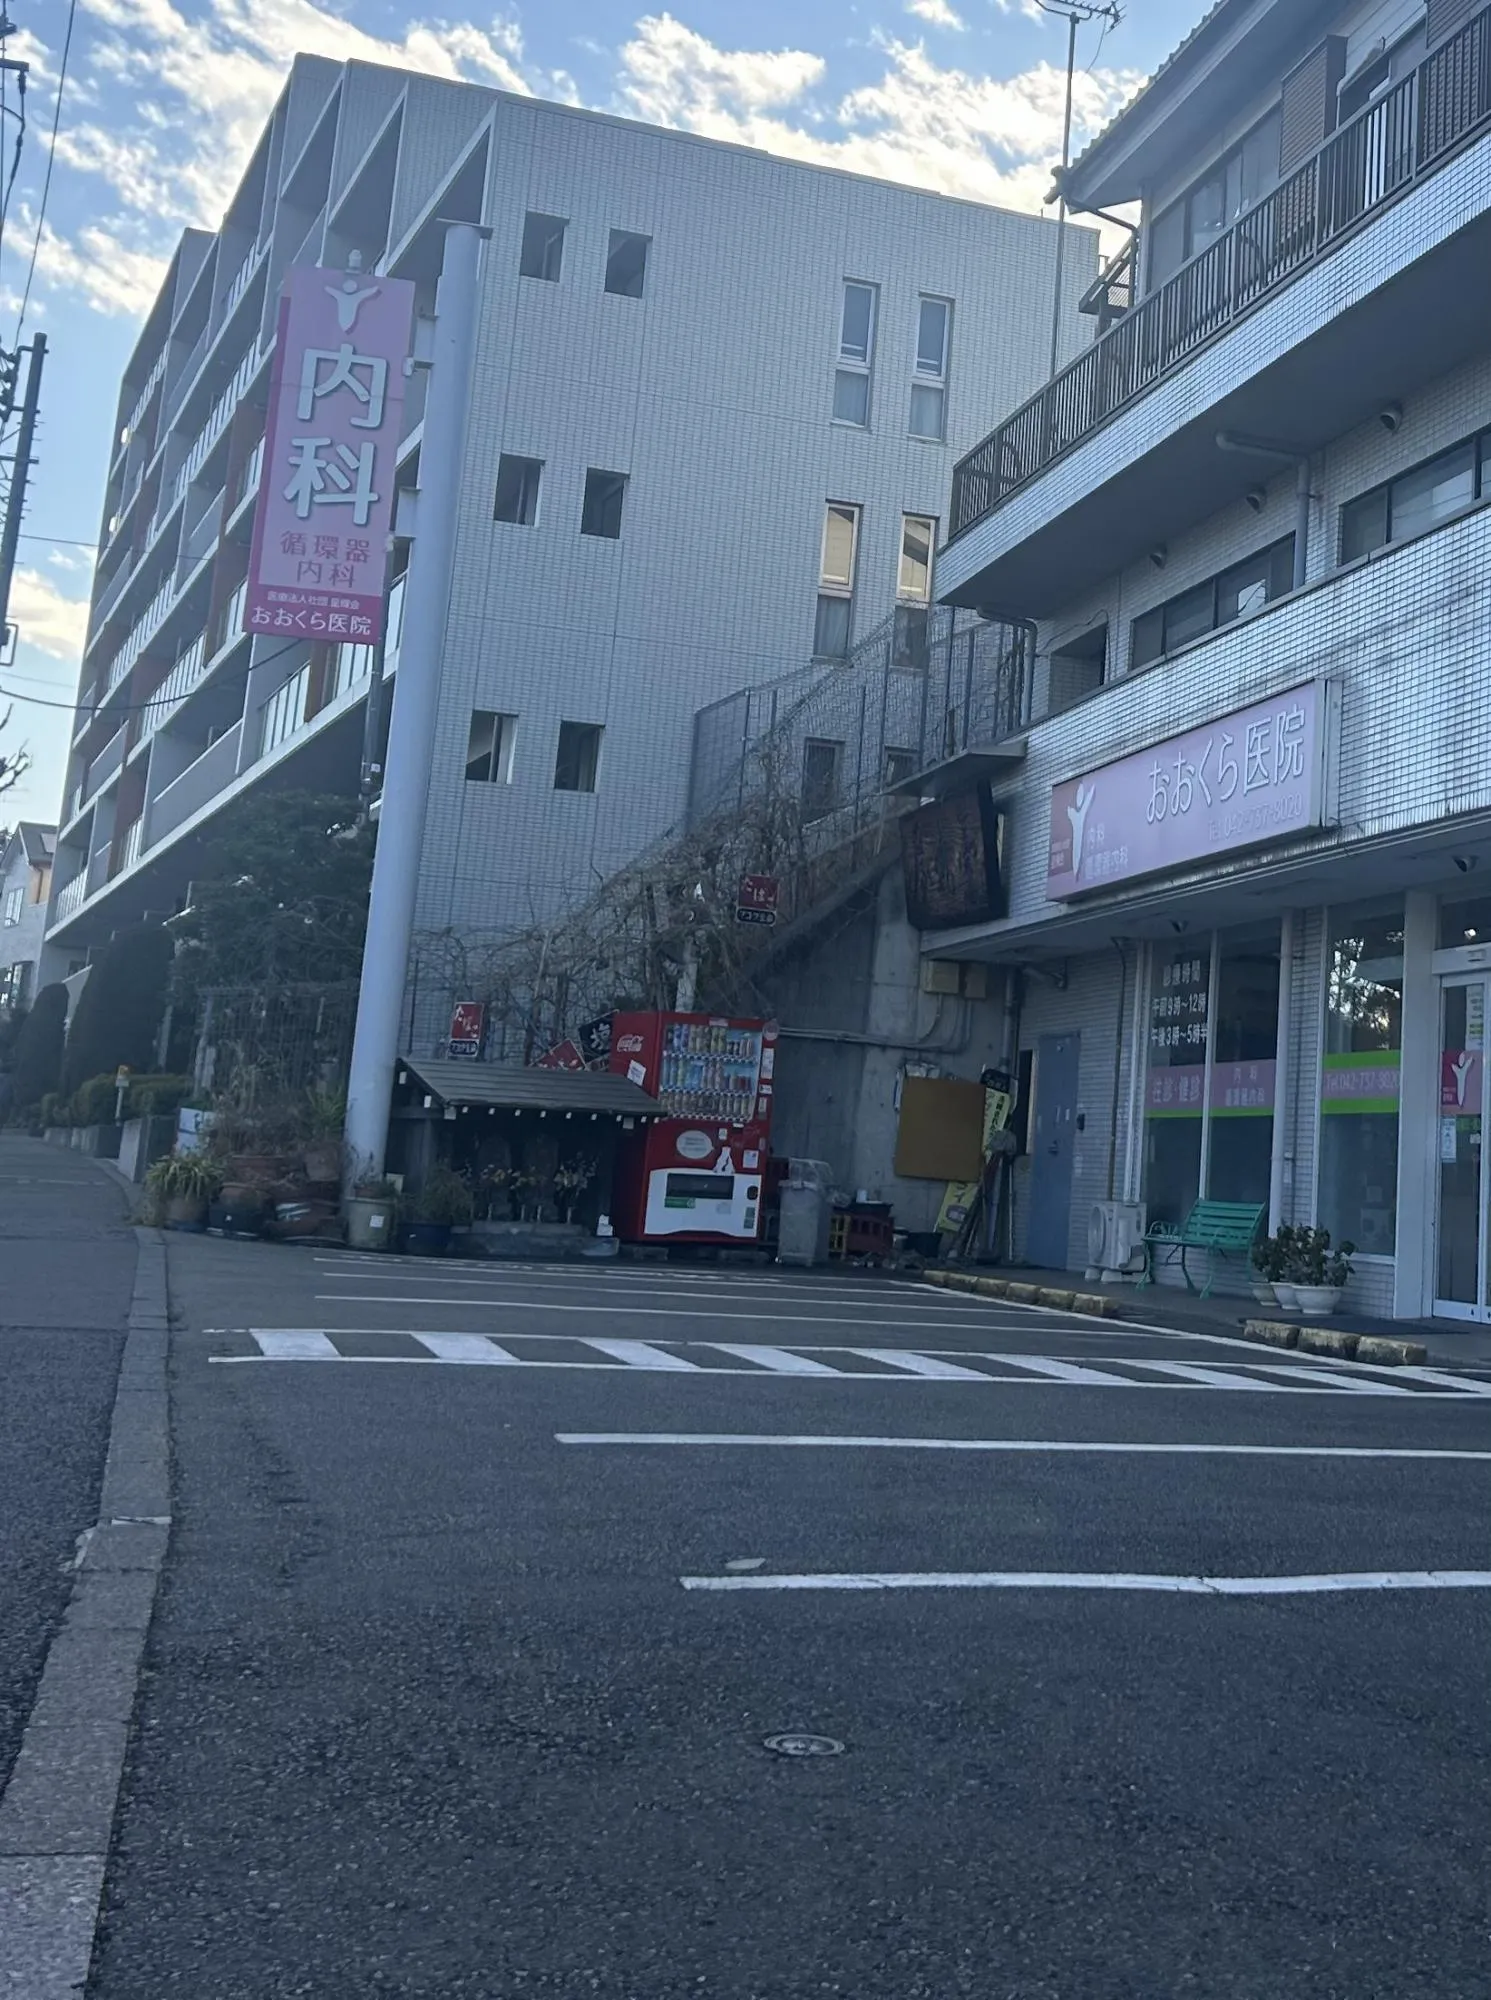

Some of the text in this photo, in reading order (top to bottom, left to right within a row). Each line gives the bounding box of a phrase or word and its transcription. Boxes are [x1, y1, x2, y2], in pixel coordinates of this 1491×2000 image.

[283, 343, 388, 526] 内科
[279, 530, 371, 564] 循環器
[297, 560, 356, 588] 内科
[251, 605, 372, 636] おおくら医院
[1146, 703, 1306, 825] おおくら医院
